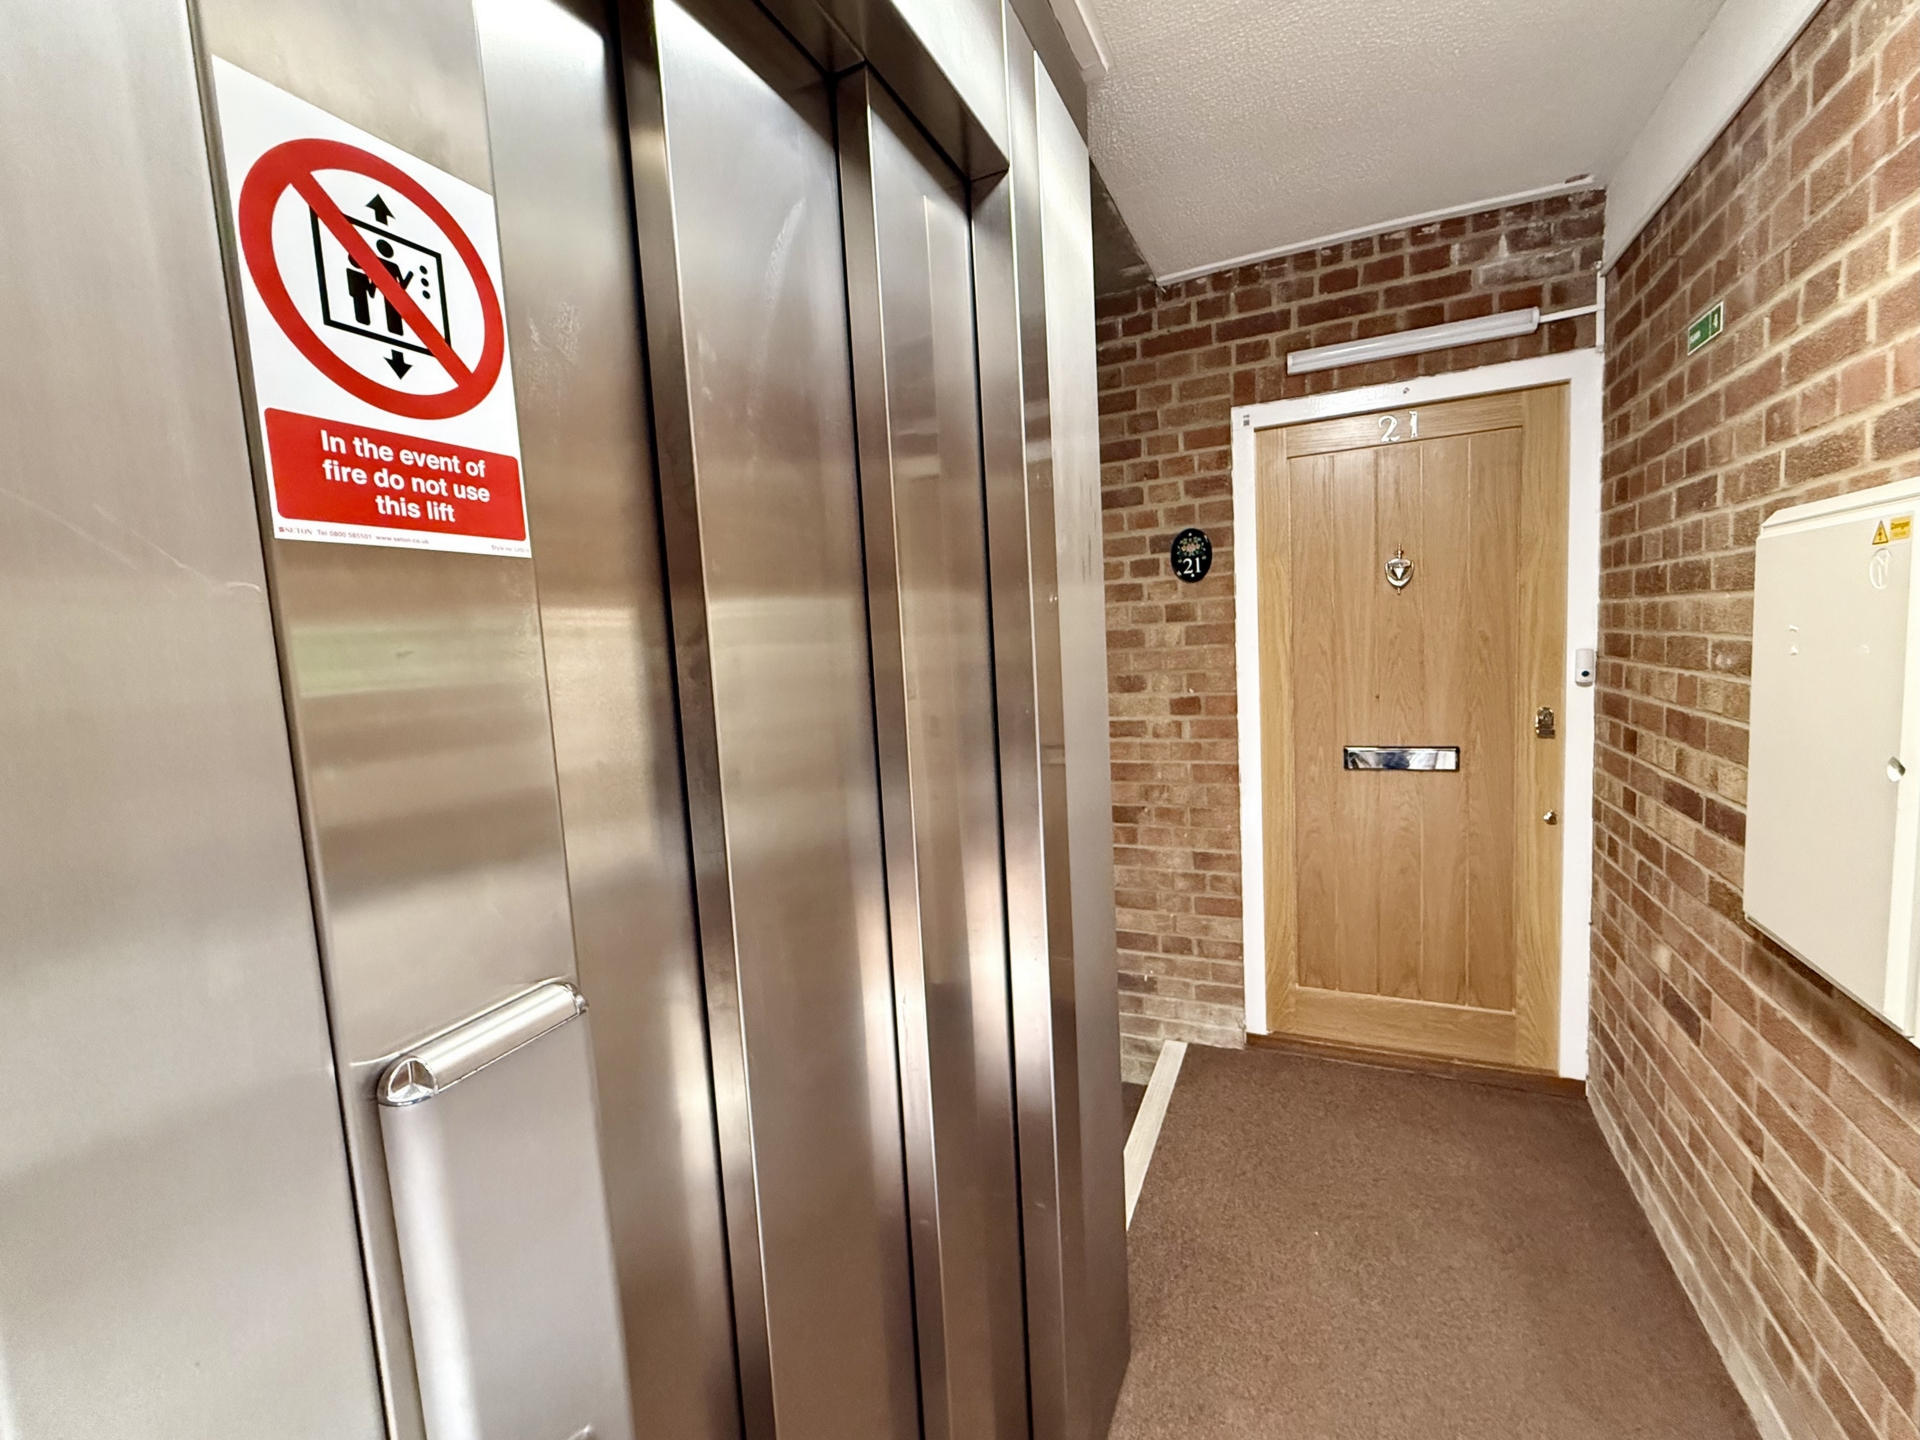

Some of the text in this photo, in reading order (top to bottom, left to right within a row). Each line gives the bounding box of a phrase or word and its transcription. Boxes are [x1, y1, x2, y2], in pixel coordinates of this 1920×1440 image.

[1378, 410, 1418, 443] 21
[320, 429, 486, 478] In the event of
[322, 458, 490, 503] fire do not use
[375, 494, 456, 523] this lift
[1182, 557, 1202, 575] 21
